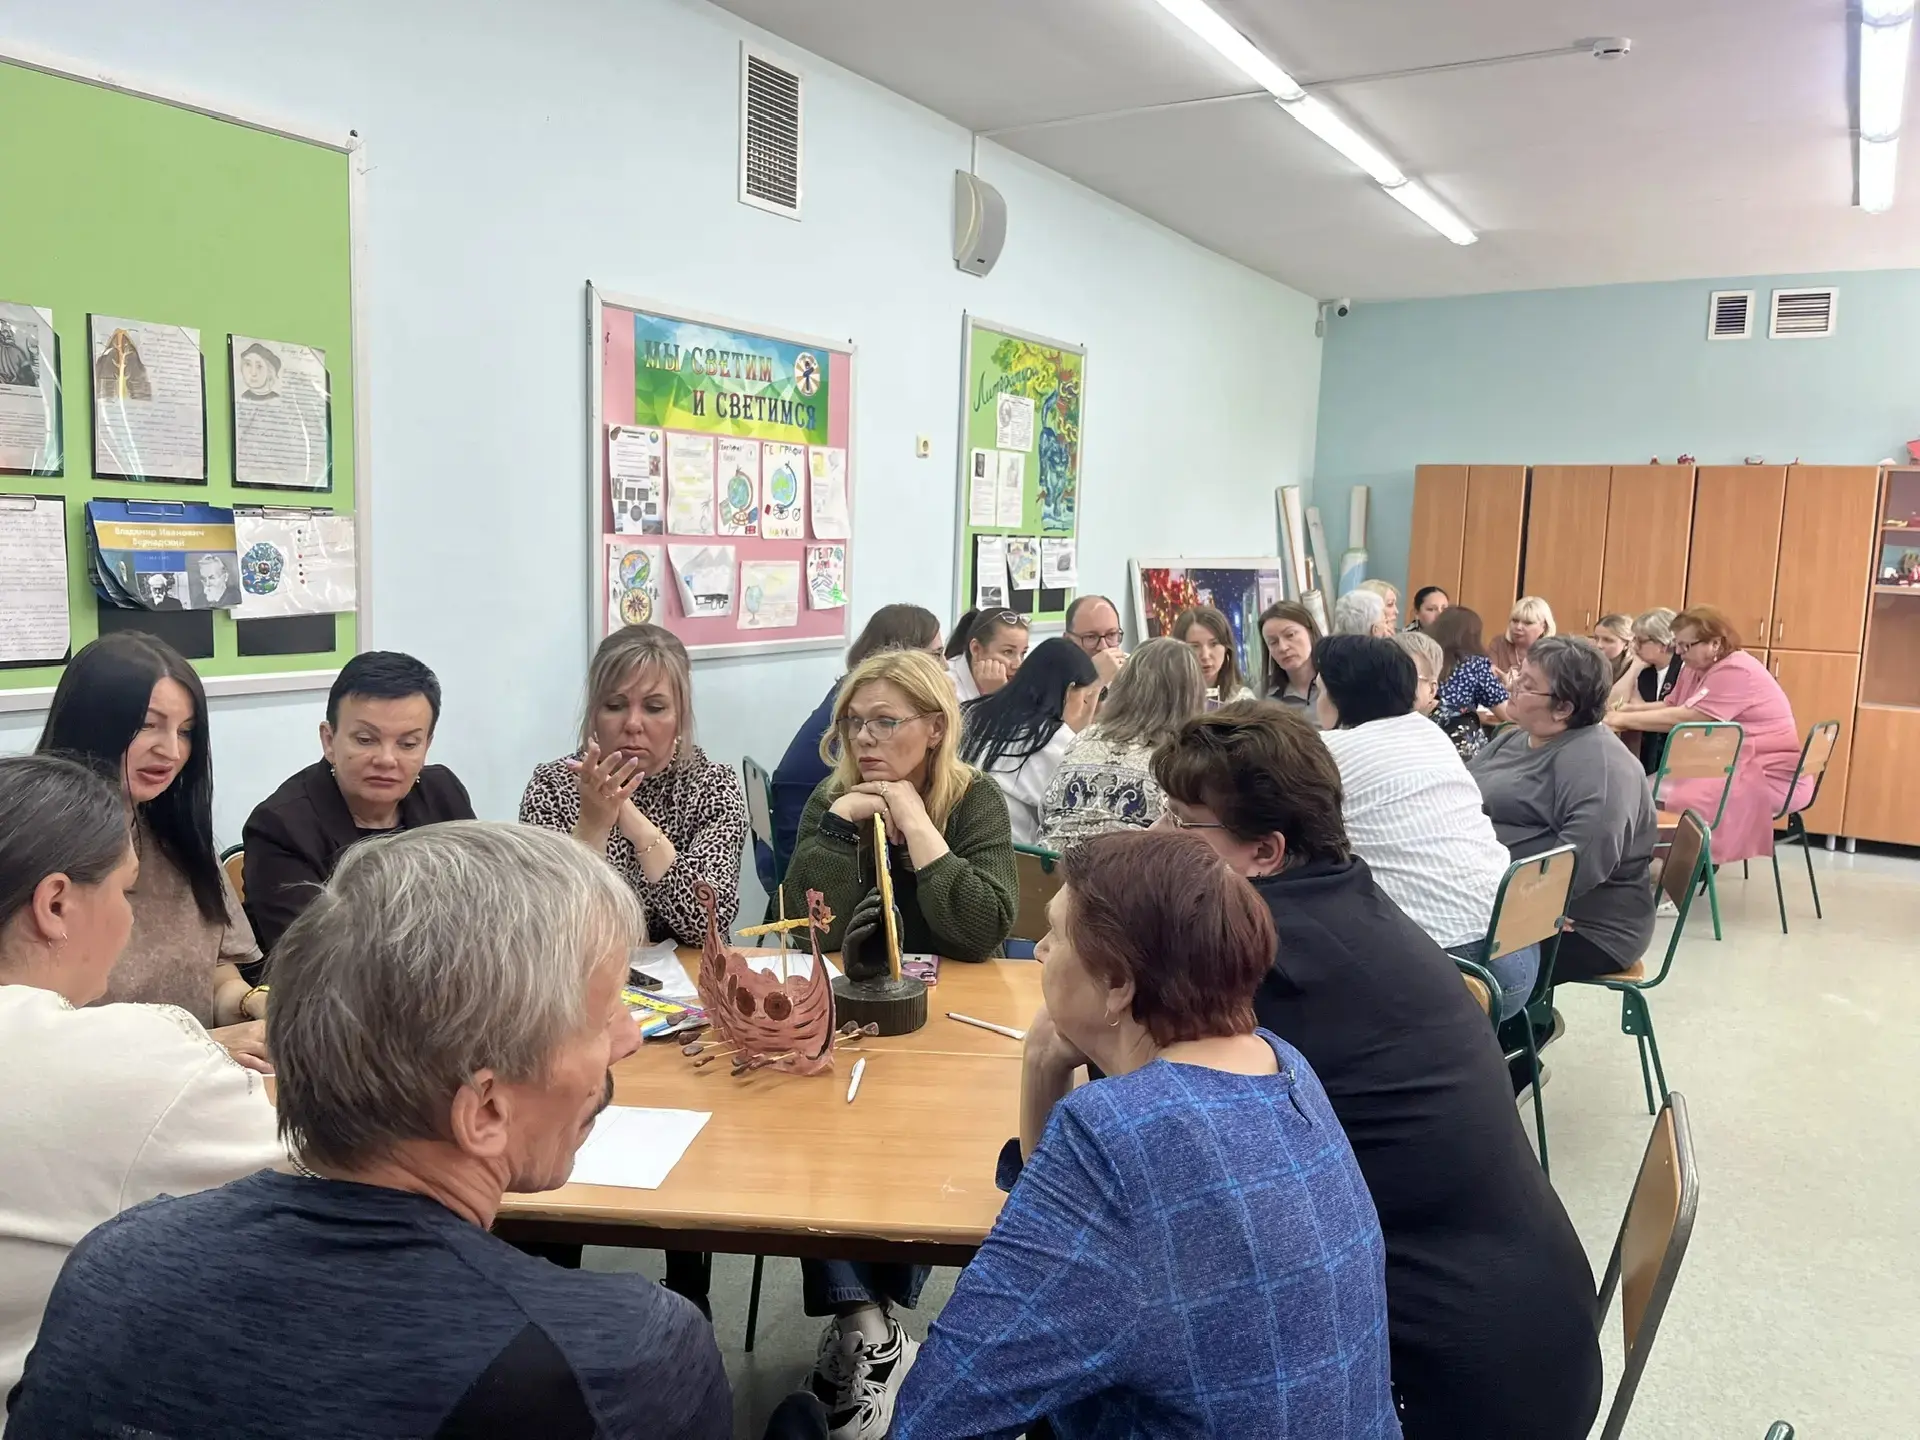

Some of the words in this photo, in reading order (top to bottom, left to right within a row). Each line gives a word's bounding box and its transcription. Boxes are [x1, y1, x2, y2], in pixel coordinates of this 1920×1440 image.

[644, 340, 681, 373] МЫ
[691, 346, 773, 383] СВЕТИМ
[692, 389, 706, 417] И
[715, 391, 817, 430] СВЕТИМСЯ
[159, 528, 206, 538] Иванович
